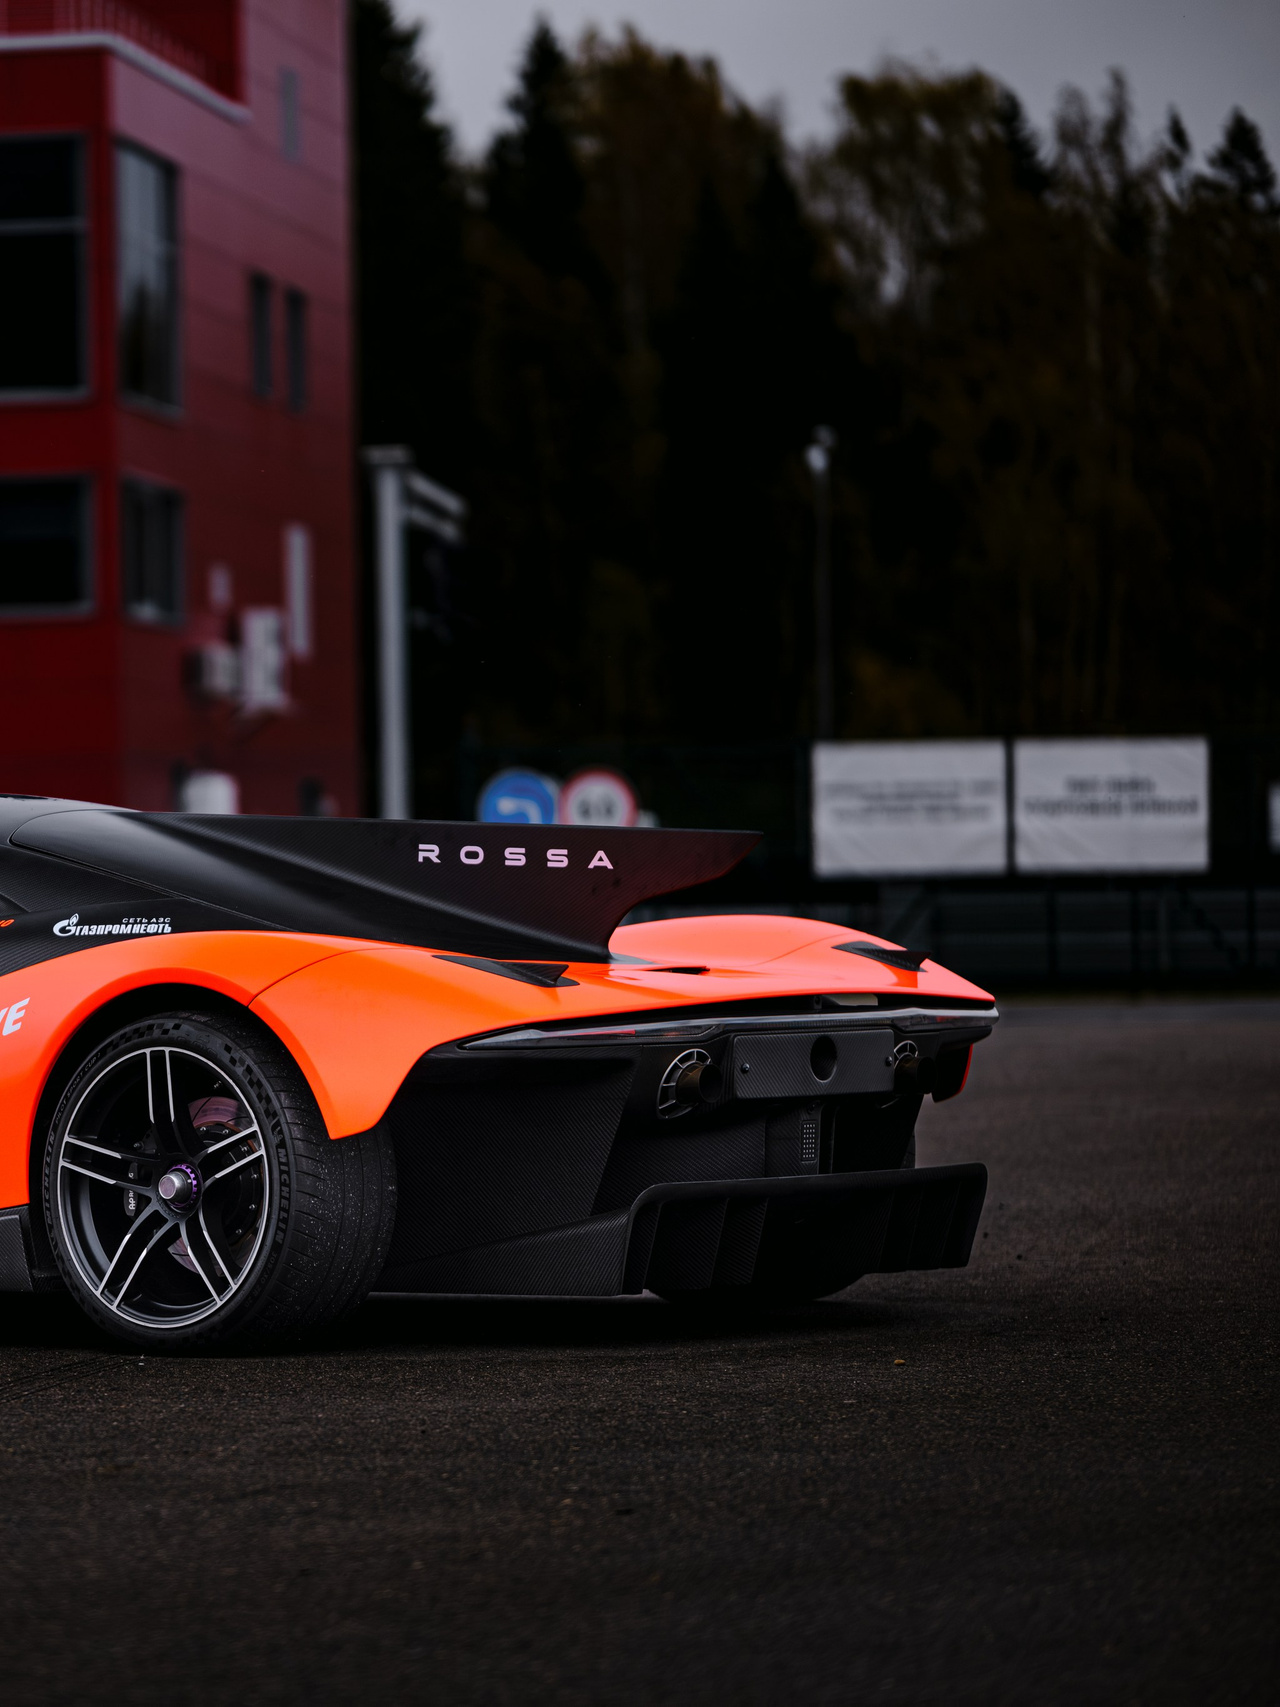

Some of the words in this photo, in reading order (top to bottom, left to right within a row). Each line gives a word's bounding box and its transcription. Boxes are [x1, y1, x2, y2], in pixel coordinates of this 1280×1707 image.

[417, 843, 614, 870] ROSSA
[44, 1130, 56, 1225] MICHELIN
[55, 1099, 68, 1124] PILOT
[66, 1071, 84, 1098] SPORT
[84, 1056, 98, 1073] CUP
[275, 1148, 291, 1244] MICHELIN
